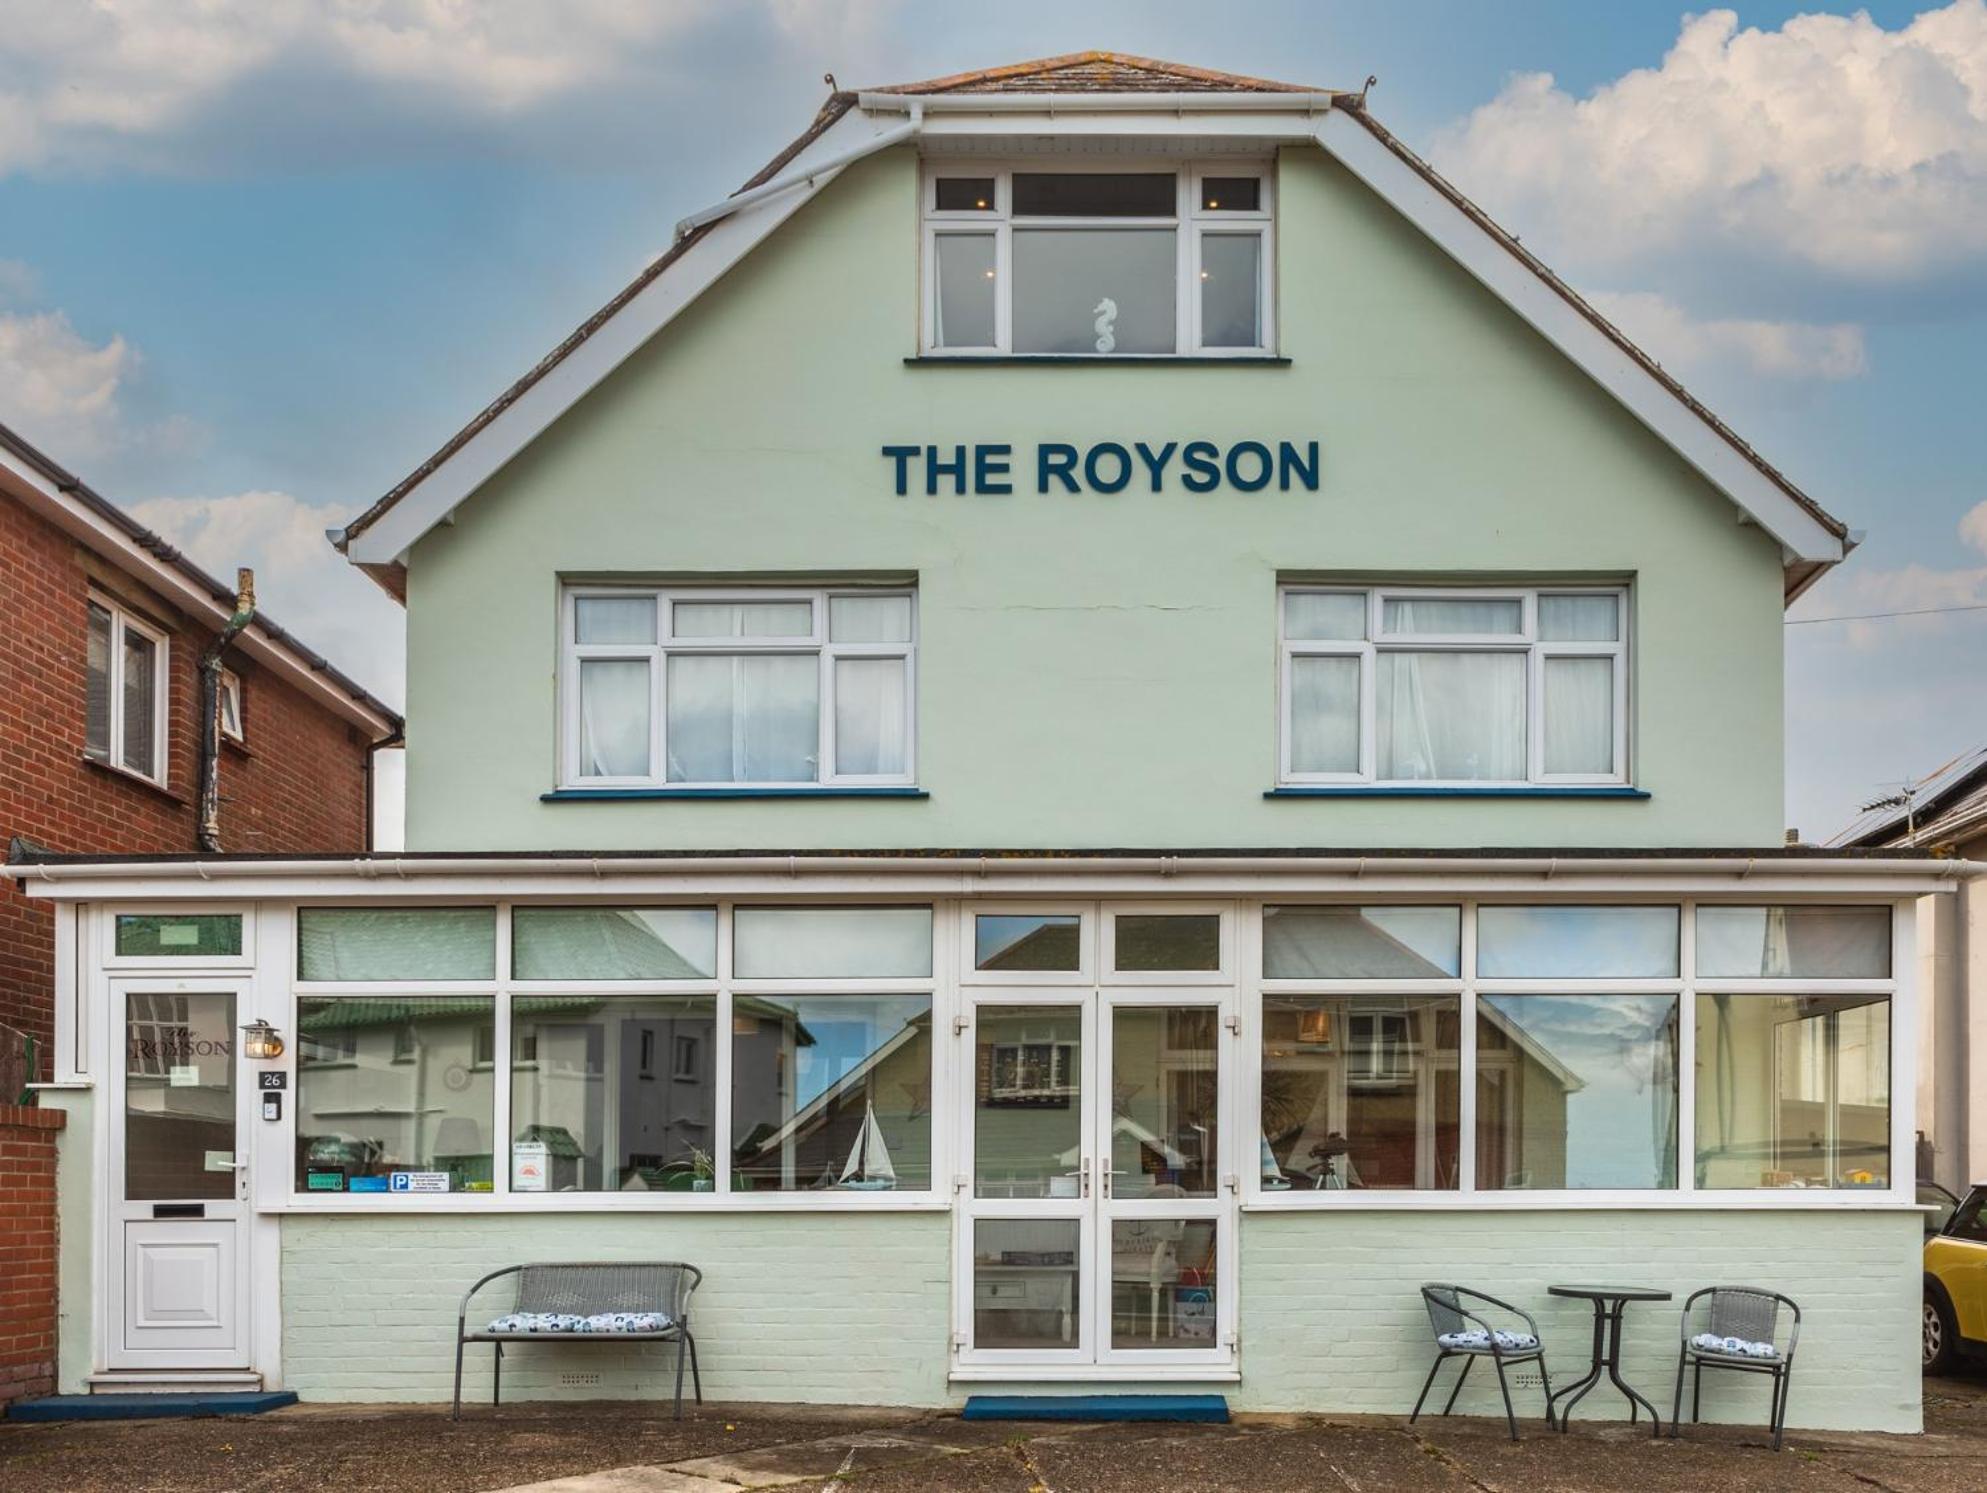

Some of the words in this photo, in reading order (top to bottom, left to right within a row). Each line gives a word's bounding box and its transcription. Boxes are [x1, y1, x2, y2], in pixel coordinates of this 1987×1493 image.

[882, 444, 1012, 495] THE
[1037, 441, 1319, 493] ROYSON
[264, 1074, 281, 1086] 26
[396, 1175, 407, 1189] P
